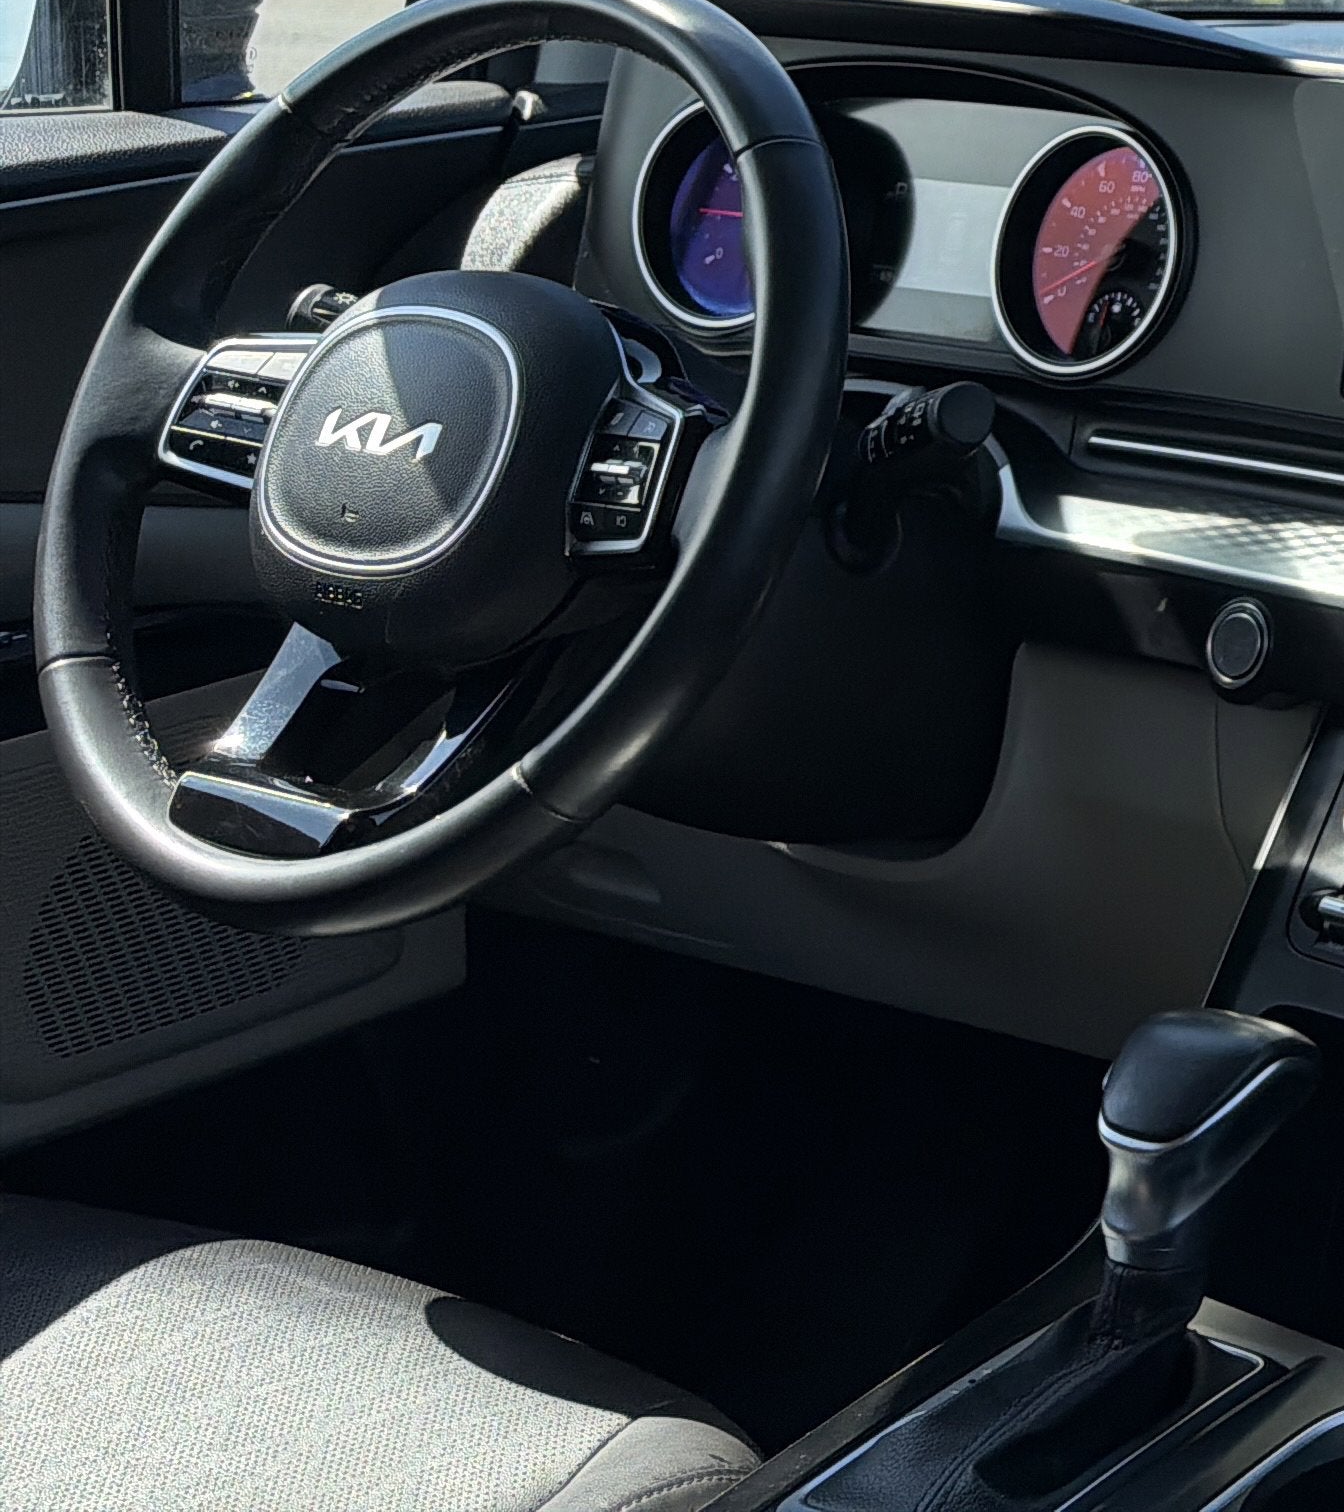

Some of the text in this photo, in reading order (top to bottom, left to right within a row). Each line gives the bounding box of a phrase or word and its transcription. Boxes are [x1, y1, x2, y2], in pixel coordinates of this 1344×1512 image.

[1132, 170, 1149, 183] 80
[1098, 180, 1116, 194] 60
[1070, 206, 1086, 219] 40
[1053, 245, 1070, 257] 20
